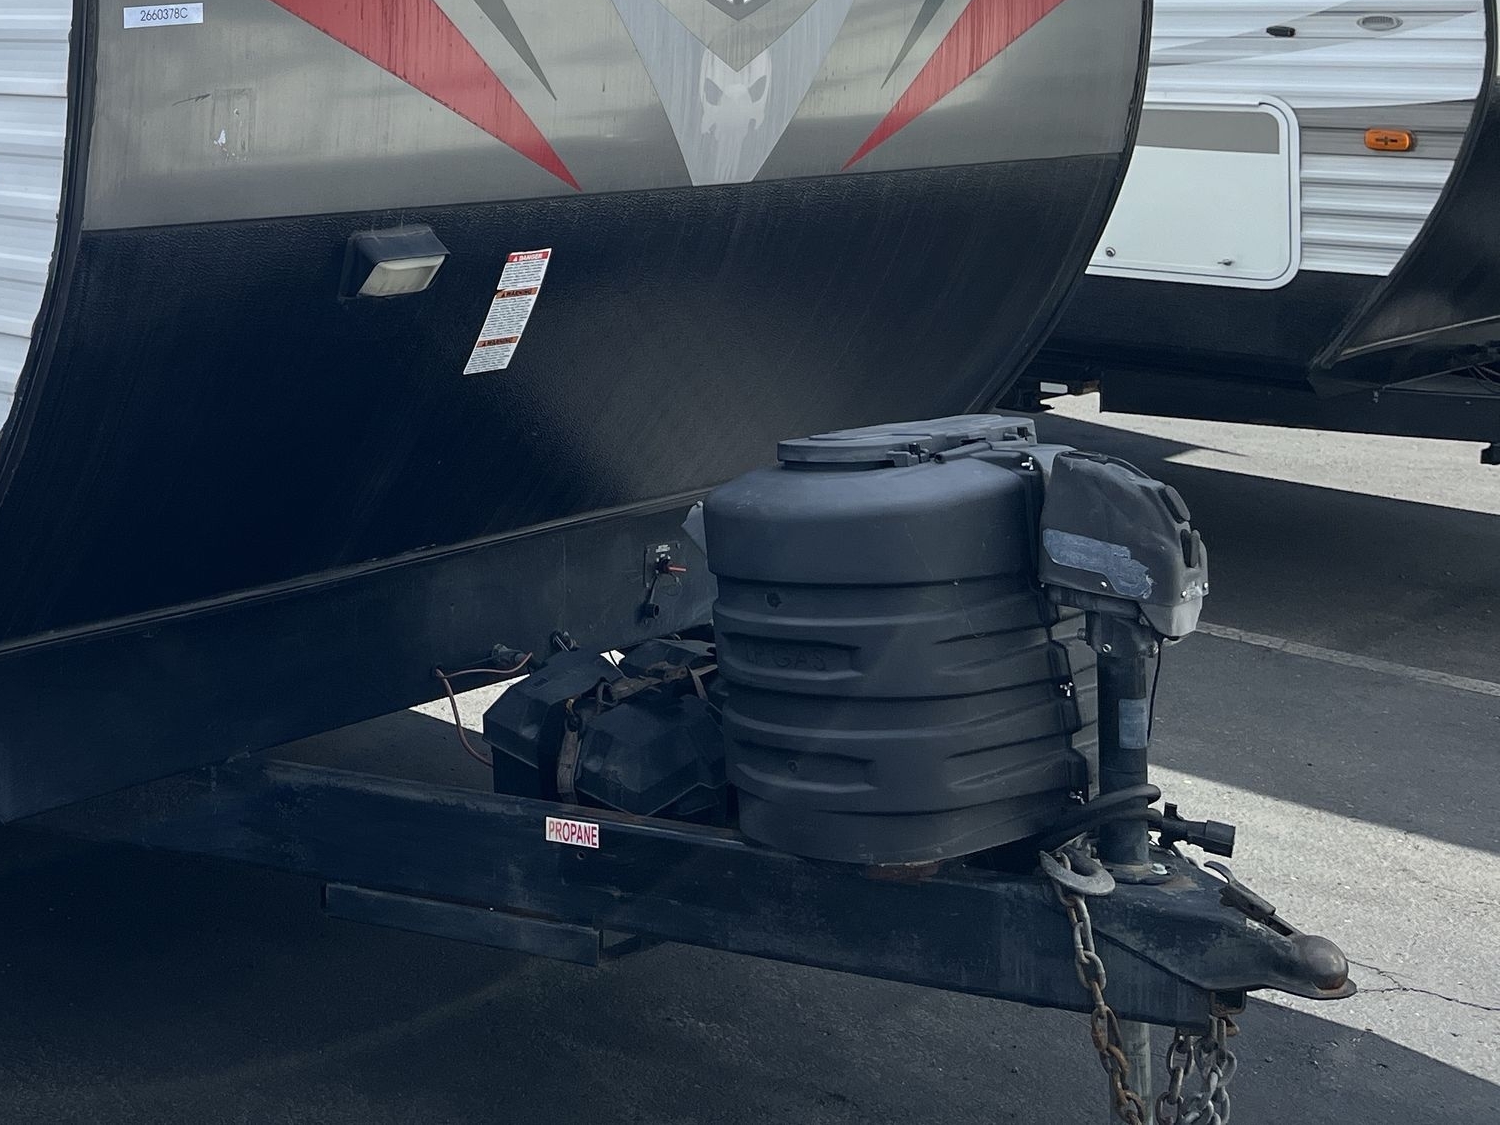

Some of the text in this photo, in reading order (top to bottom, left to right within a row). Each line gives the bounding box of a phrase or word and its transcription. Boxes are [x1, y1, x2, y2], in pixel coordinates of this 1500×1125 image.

[140, 6, 189, 22] 2660378C
[518, 252, 543, 261] DANGER
[548, 820, 598, 847] PROPANE
